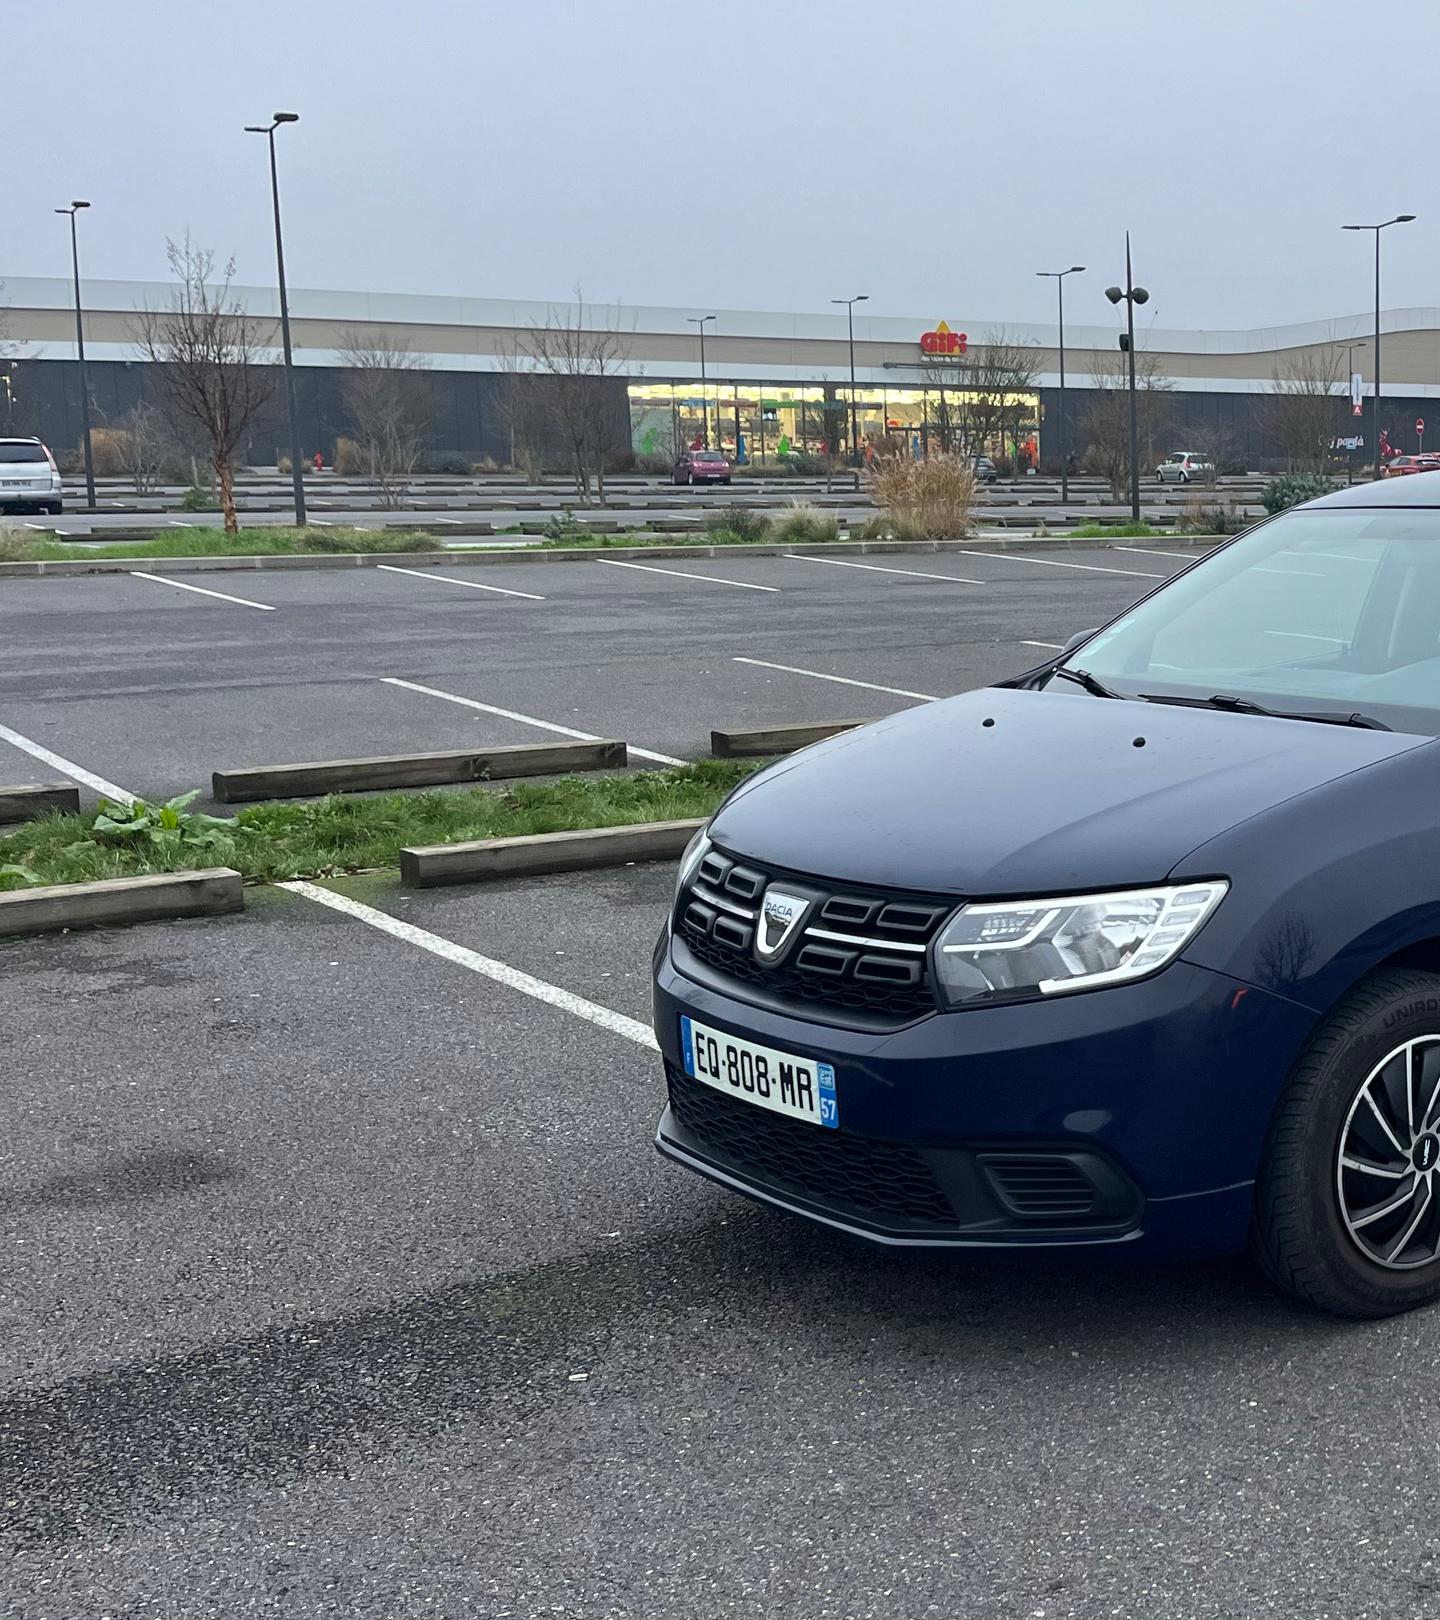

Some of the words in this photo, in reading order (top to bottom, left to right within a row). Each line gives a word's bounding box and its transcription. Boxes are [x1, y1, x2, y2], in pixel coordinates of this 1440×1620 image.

[765, 902, 793, 916] DACIA
[686, 1052, 691, 1064] F
[821, 1096, 836, 1120] 57
